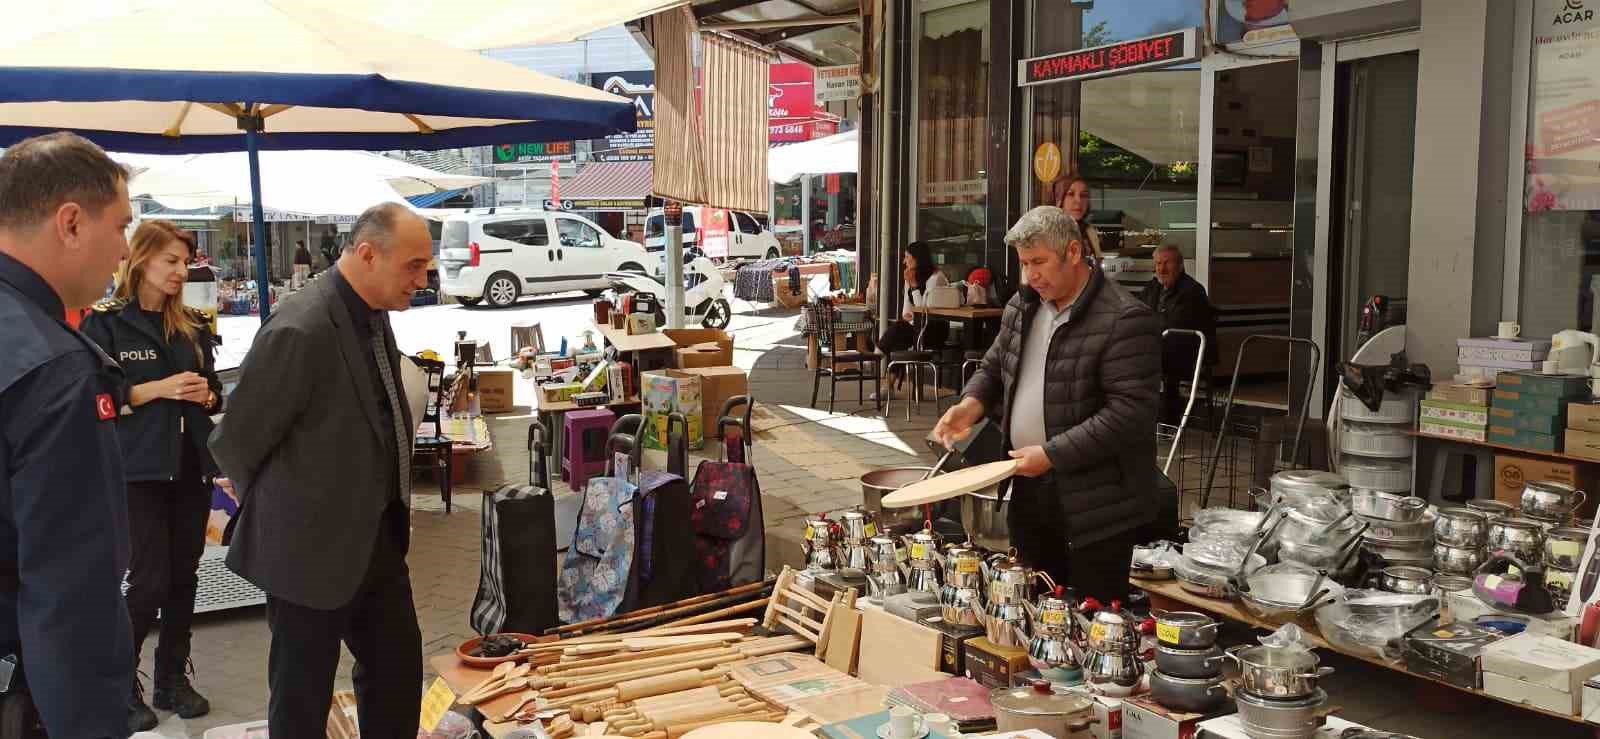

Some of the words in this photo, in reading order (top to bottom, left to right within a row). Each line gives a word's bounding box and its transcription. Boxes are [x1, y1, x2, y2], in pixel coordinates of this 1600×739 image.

[1553, 10, 1593, 24] ACAR
[1033, 48, 1105, 79] KAYMAKLI
[519, 143, 544, 155] NEW
[545, 142, 570, 154] LIFE
